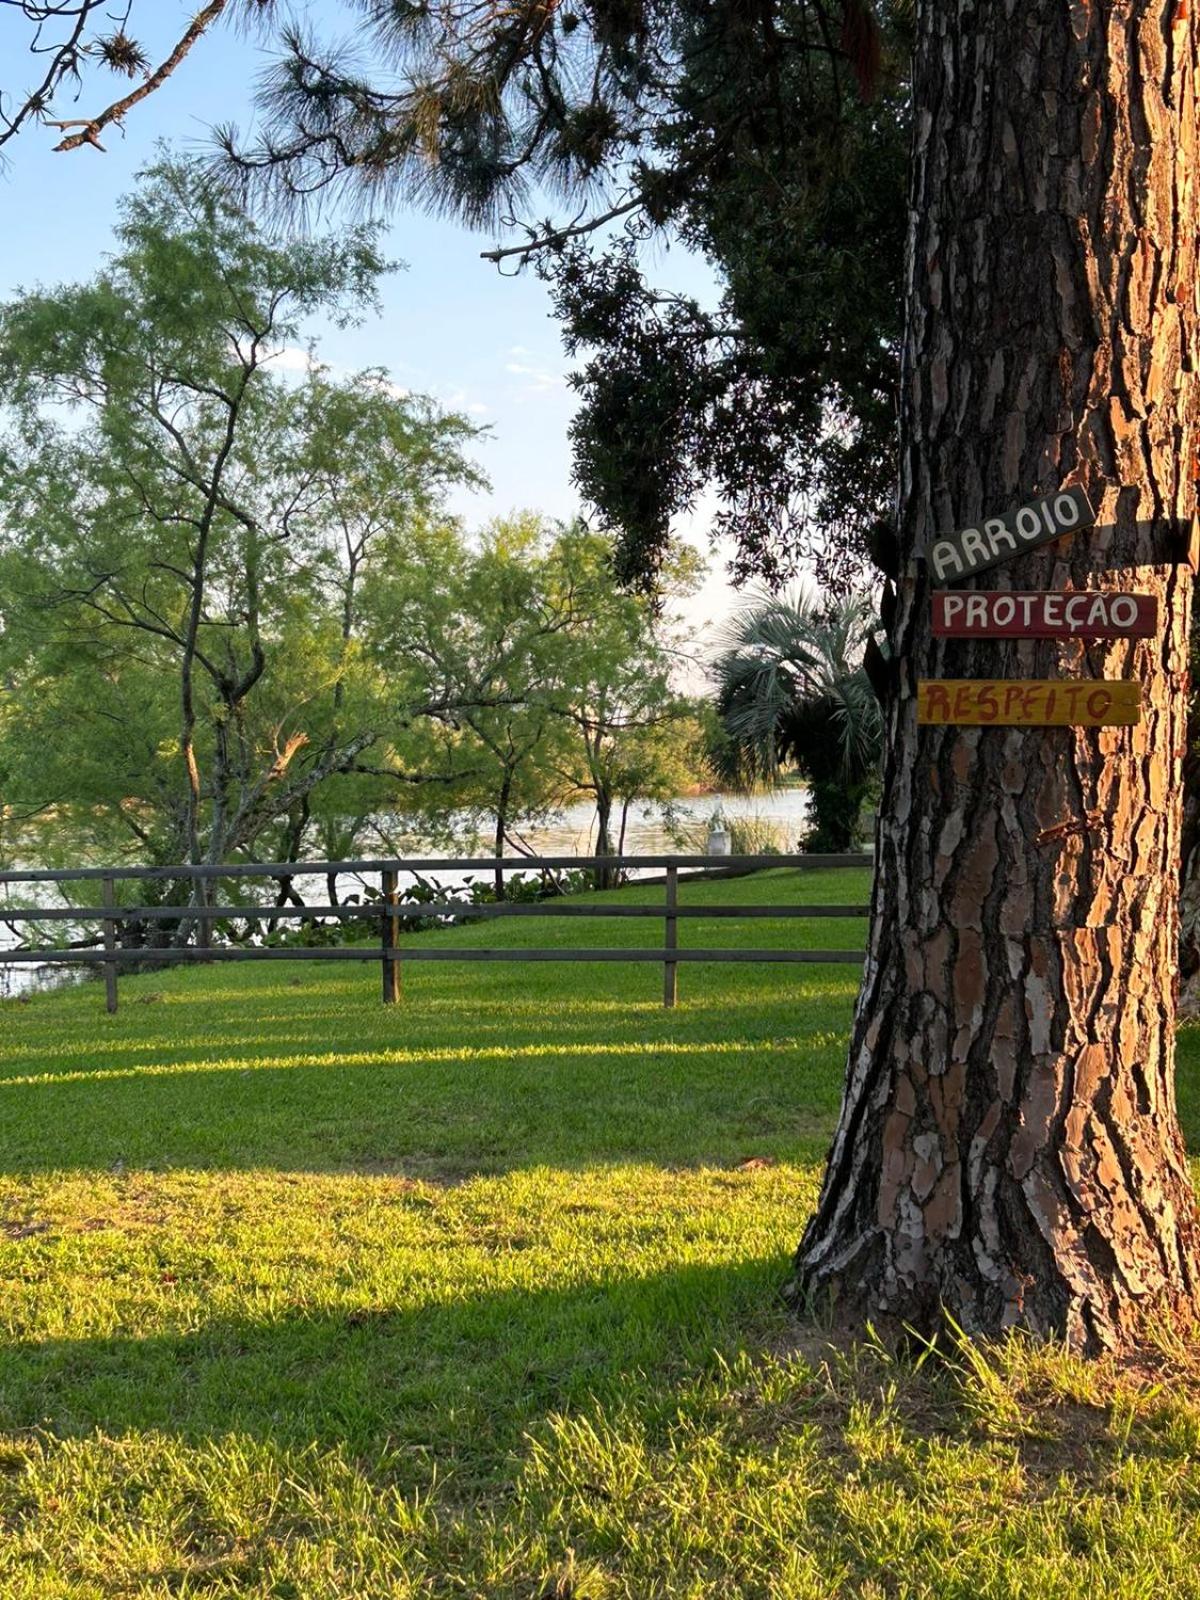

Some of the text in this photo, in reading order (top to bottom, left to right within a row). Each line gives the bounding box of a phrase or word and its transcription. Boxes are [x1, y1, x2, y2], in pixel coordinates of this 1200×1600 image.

[932, 494, 1080, 580] ARROIO
[943, 592, 1138, 632] PROTEÇÃO
[925, 685, 1112, 720] RESPEITO
